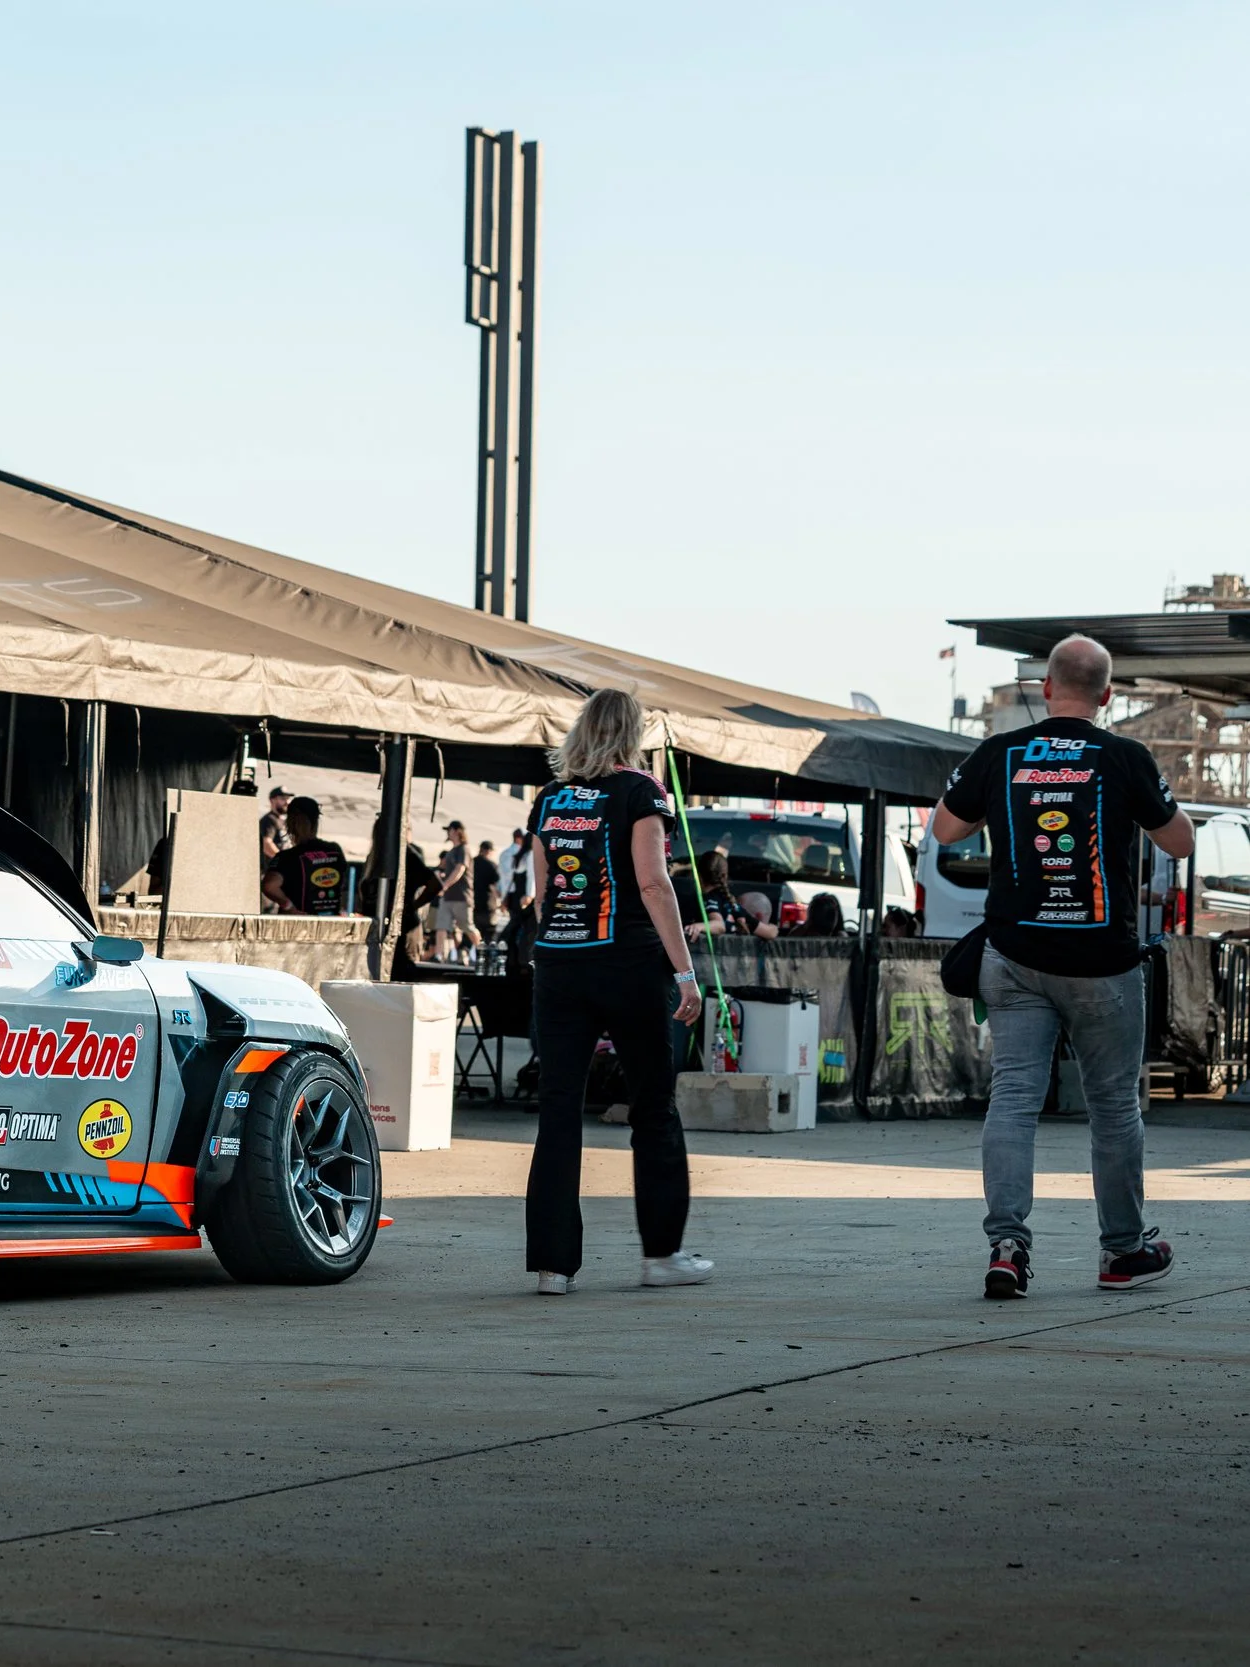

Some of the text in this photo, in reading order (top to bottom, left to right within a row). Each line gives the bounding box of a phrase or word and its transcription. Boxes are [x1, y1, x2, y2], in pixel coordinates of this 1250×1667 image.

[1050, 737, 1087, 750] 130
[1027, 768, 1091, 784] AutoZone
[550, 817, 599, 831] AutoZone
[1041, 857, 1073, 866] FORD
[10, 1113, 58, 1141] OPTIMA
[84, 1115, 125, 1142] PENNZOIL
